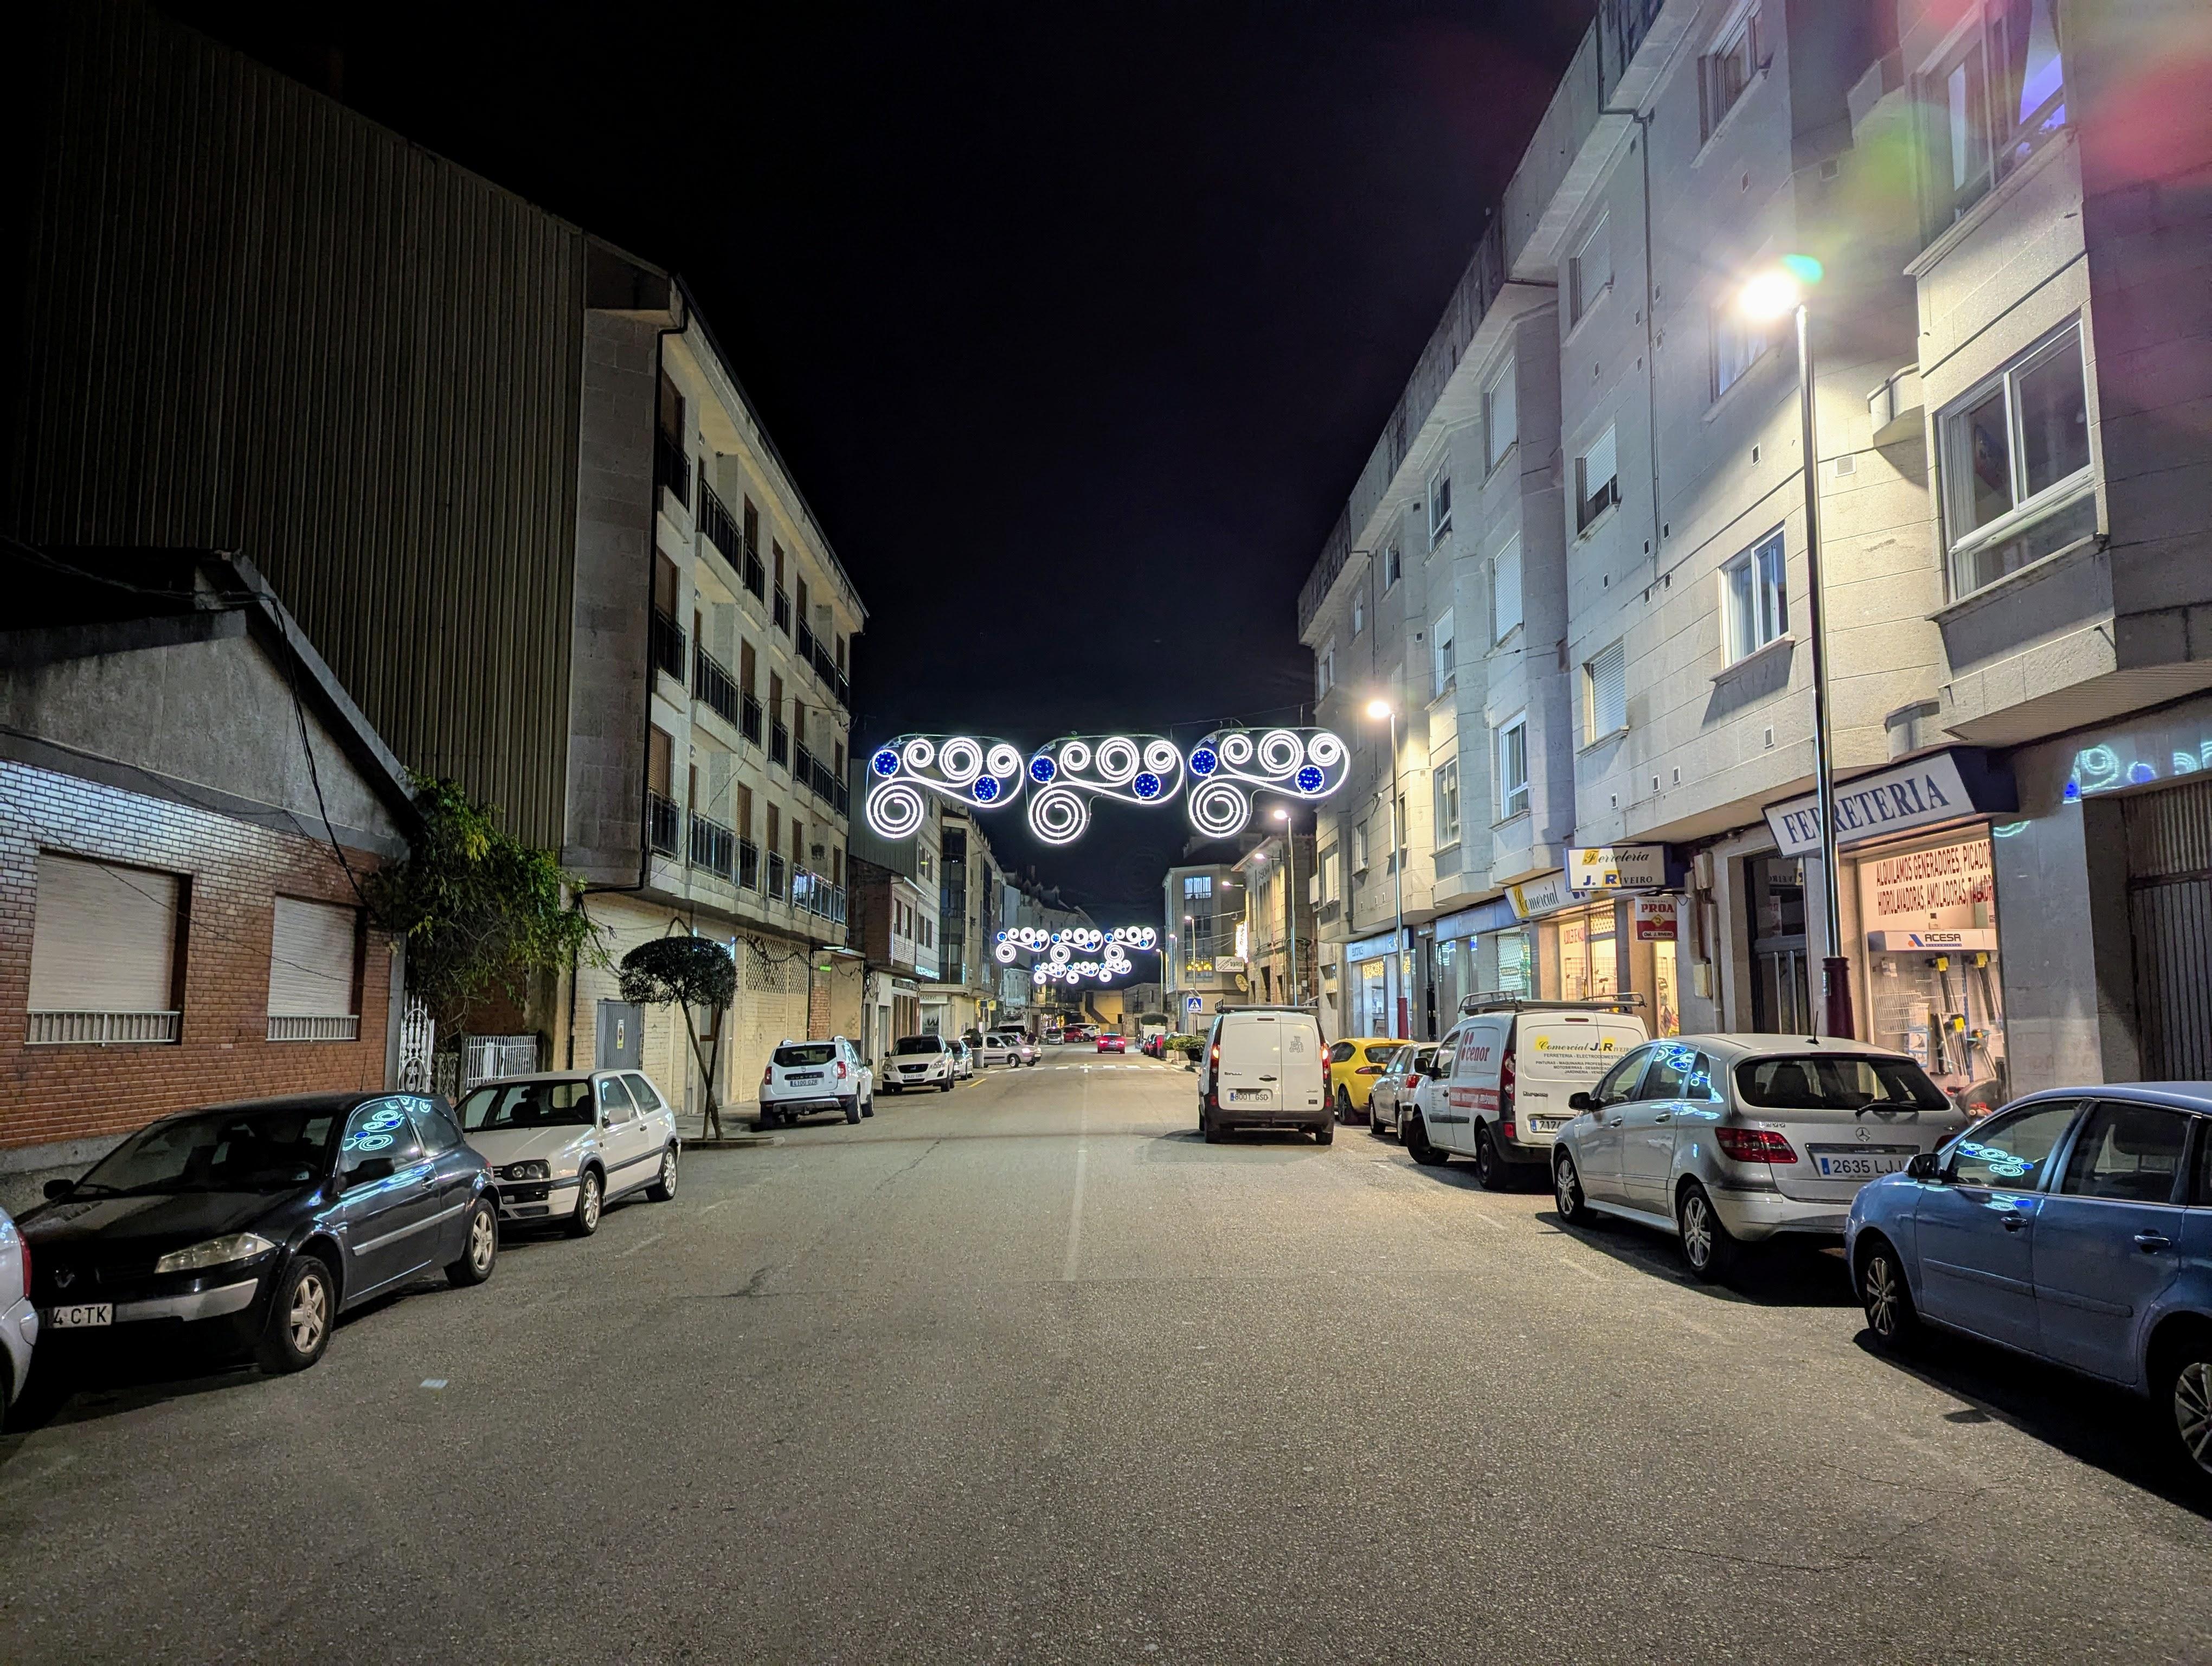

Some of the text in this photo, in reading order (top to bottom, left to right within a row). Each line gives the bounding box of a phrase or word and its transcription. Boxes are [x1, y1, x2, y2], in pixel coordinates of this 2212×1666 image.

[1782, 774, 1951, 844] FERRETERIA
[1584, 850, 1649, 864] Ferreteria
[1876, 856, 1913, 887] ALQUILAMOS
[1913, 847, 1963, 880] GENERADORES,
[1583, 874, 1653, 886] J. RIVEIRO
[1515, 880, 1560, 913] Comercial
[1877, 885, 1927, 916] HIDROLAVADORAS,
[1927, 877, 1968, 909] AMOLADORAS,
[1641, 904, 1675, 913] PROA
[1925, 933, 1962, 942] ACESA
[1539, 1041, 1590, 1051] Comercial
[1466, 1046, 1490, 1061] cenor
[1234, 1093, 1251, 1101] 8001
[1832, 1159, 1870, 1173] 2635
[71, 1306, 108, 1324] CTK
